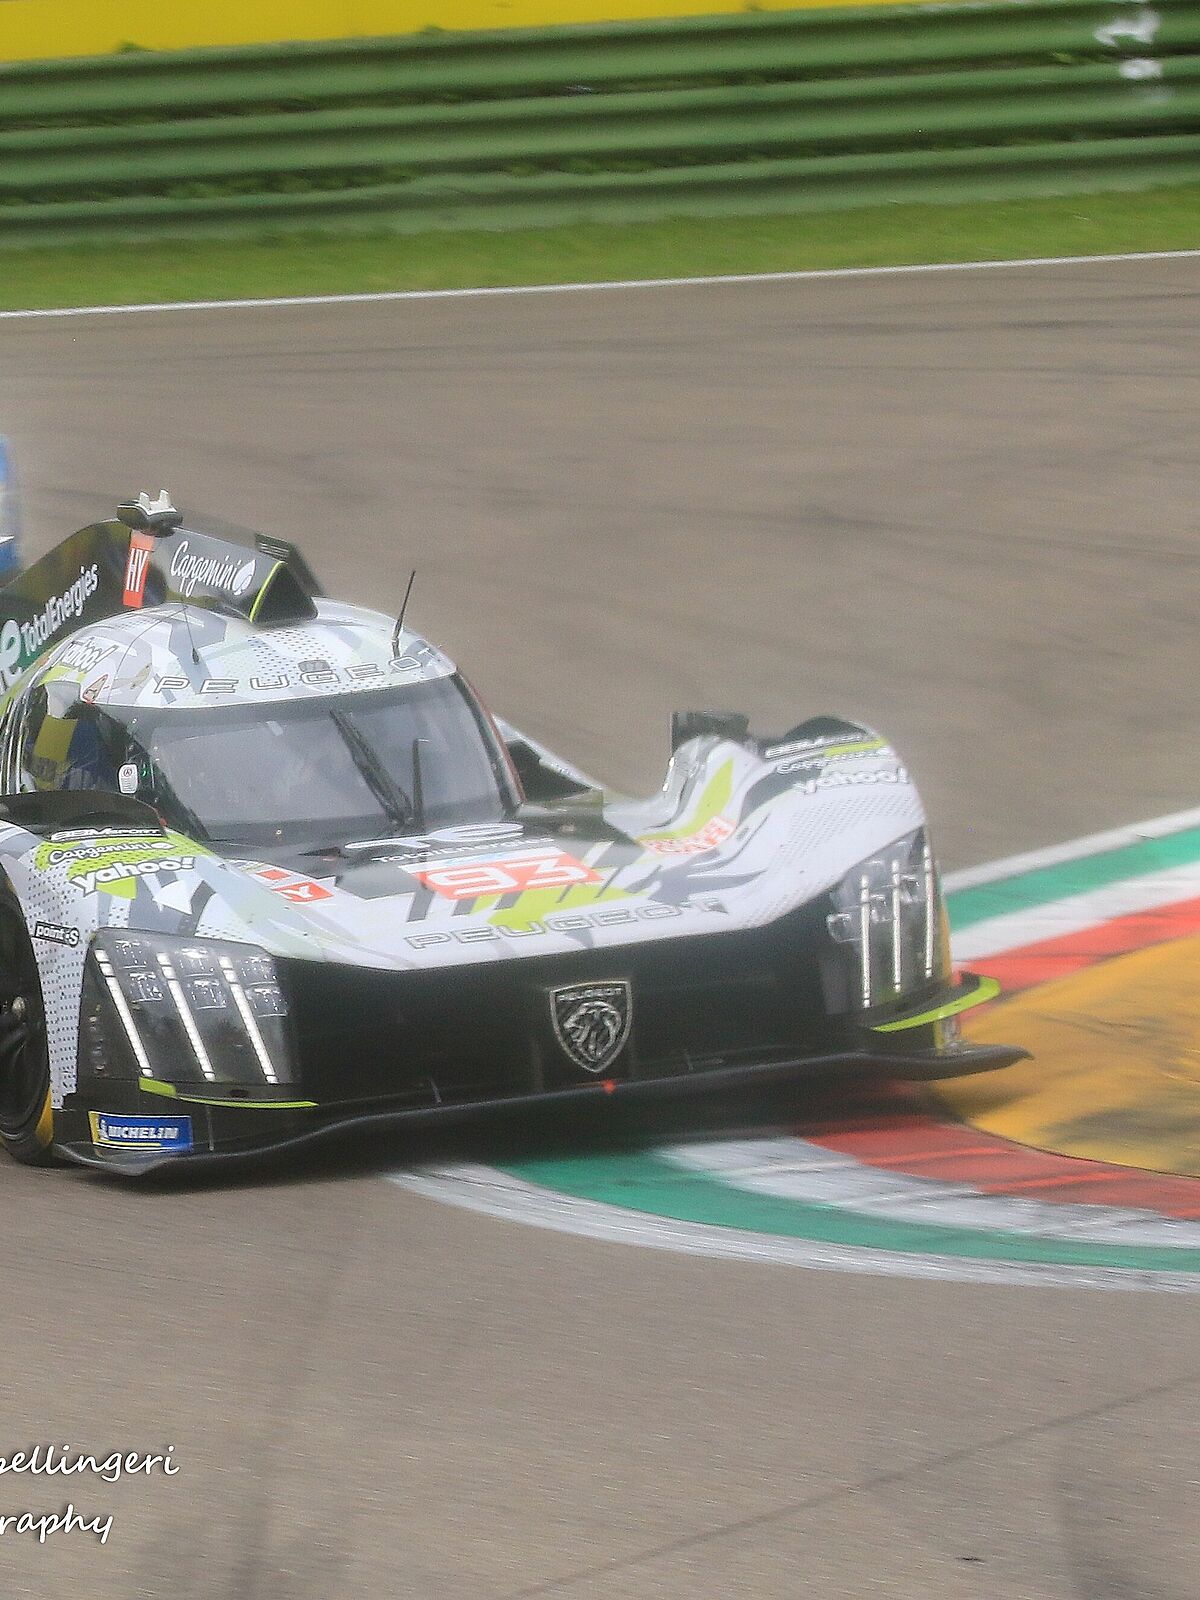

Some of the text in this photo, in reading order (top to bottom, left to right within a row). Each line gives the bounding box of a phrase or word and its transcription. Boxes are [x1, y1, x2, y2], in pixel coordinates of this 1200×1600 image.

[125, 548, 149, 592] HY
[171, 541, 242, 597] Capgemini
[20, 563, 99, 656] TotalEnergies
[154, 647, 436, 694] PEUGEOT
[49, 842, 150, 865] Capgemini
[69, 857, 195, 897] yahoo!
[426, 857, 588, 896] 93
[403, 898, 721, 949] PEUGEOT
[108, 1125, 179, 1140] MICHELIN
